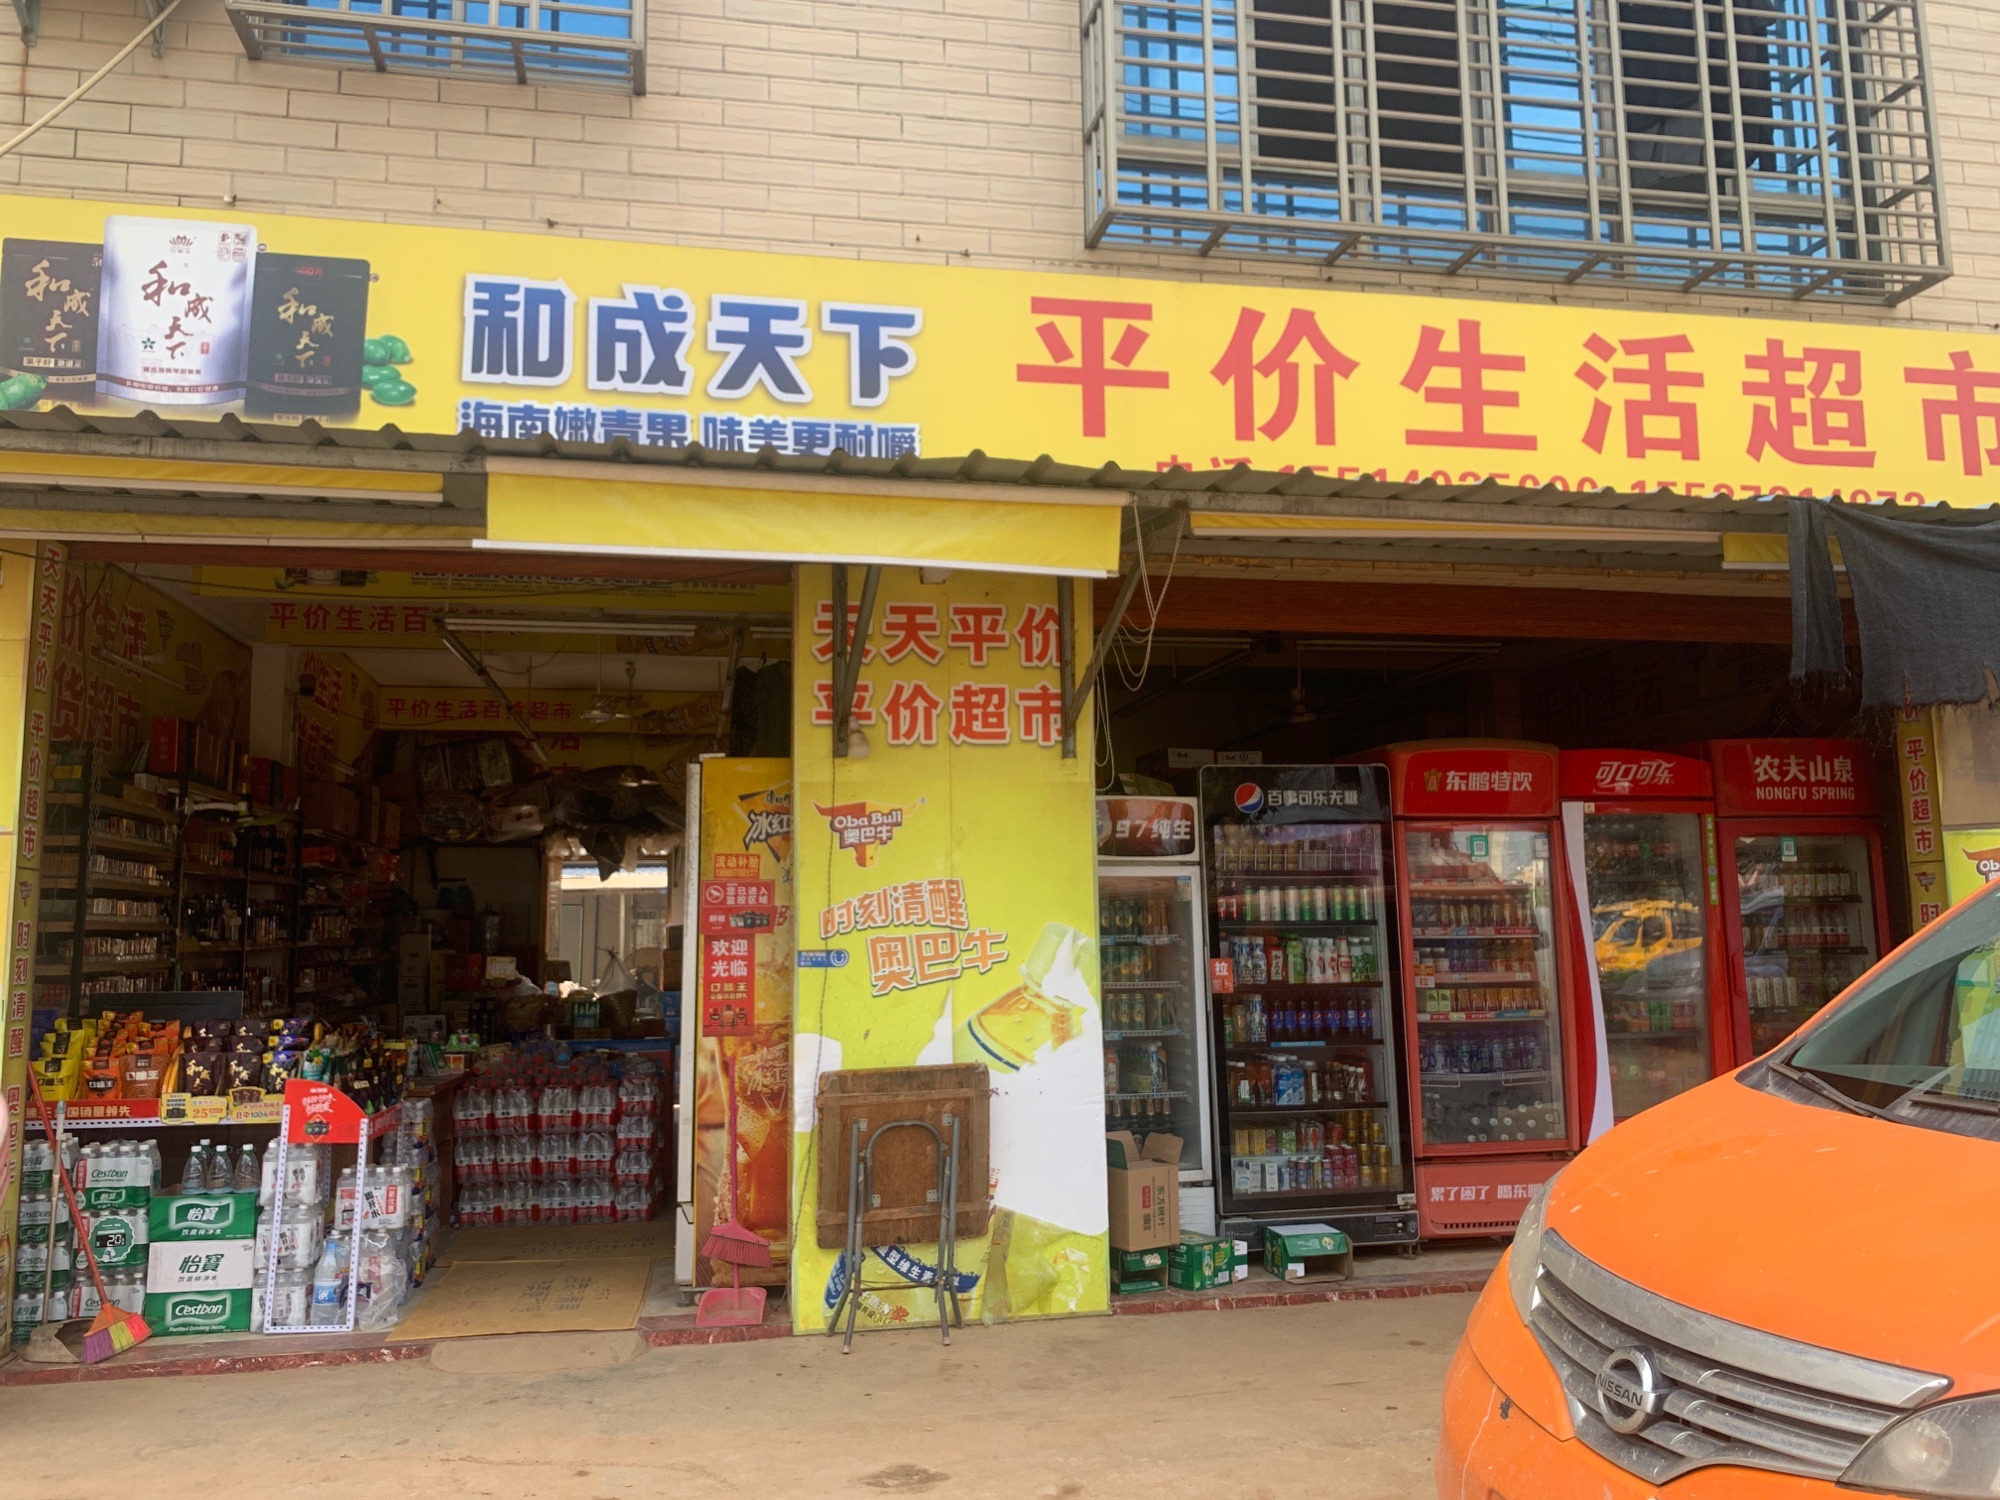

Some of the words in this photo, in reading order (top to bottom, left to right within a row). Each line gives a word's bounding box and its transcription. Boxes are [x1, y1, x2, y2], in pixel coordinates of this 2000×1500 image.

[464, 274, 921, 404] 和成天下
[1016, 295, 2000, 476] 平价生活超市
[36, 546, 62, 693] 天天平价
[812, 681, 1064, 746] 平价超市
[1446, 770, 1533, 792] 东鹏特饮
[1595, 760, 1676, 786] 可口可乐
[1753, 755, 1854, 783] 农夫山泉
[23, 711, 47, 860] 平价超市
[1756, 786, 1807, 800] NONGFU
[1812, 786, 1856, 801] SPRING
[1905, 739, 1932, 852] 平价超市
[834, 814, 868, 829] Oba
[870, 810, 901, 825] Bull
[844, 825, 892, 845] 奥巴牛
[820, 878, 968, 938] 时刻清醒
[711, 939, 749, 956] 欢迎
[867, 928, 1008, 997] 奥巴牛
[711, 959, 749, 978] 光临
[9, 921, 32, 1057] 时刻清醒
[193, 1109, 208, 1118] 25
[1430, 1186, 1490, 1202] 累了困了
[1597, 1373, 1643, 1407] NISSAN
